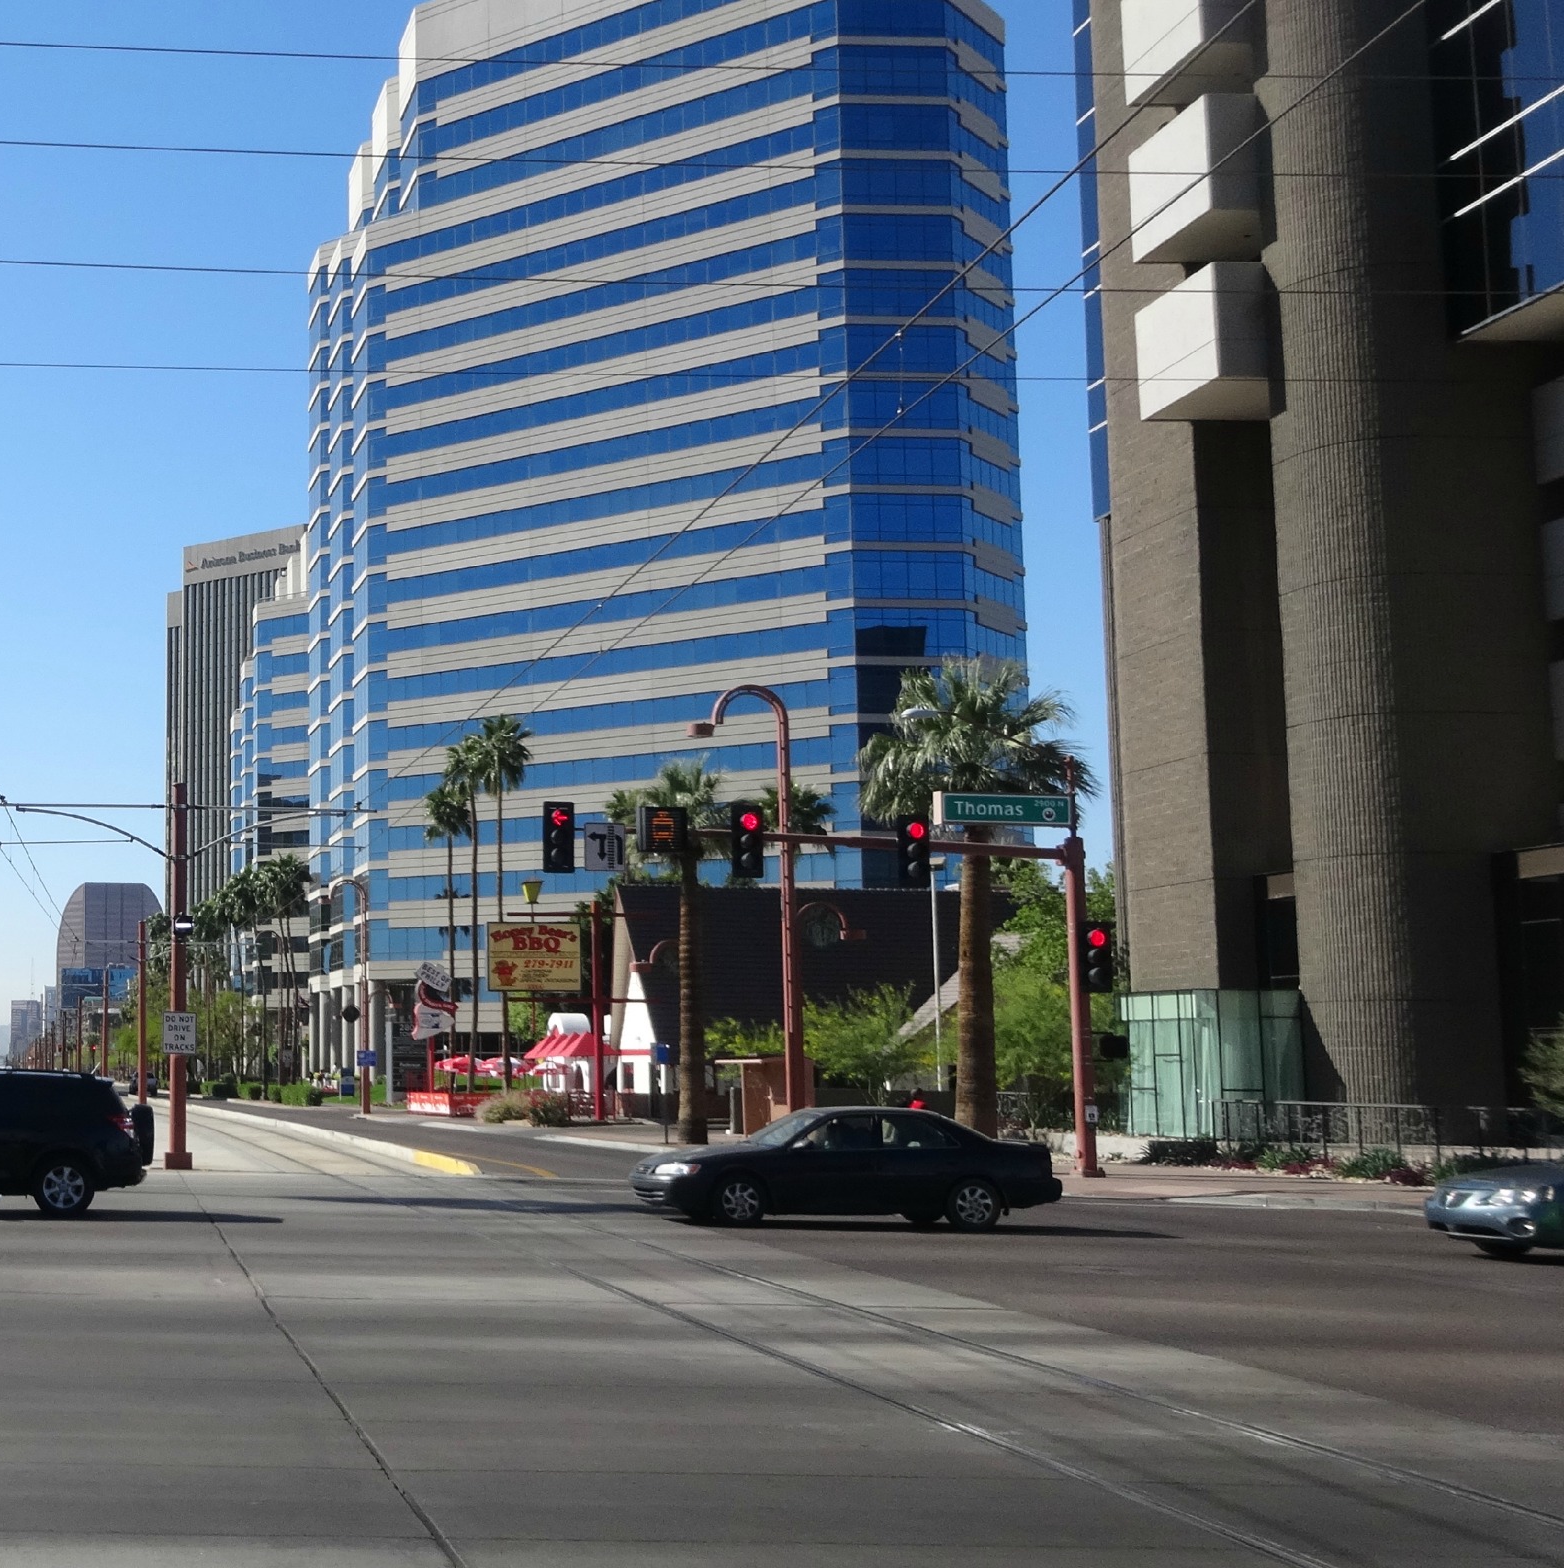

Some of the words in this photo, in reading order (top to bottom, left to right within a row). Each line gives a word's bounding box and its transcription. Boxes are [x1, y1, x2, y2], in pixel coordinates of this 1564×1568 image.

[238, 547, 277, 562] Business
[954, 801, 1024, 816] Thomas
[1034, 799, 1055, 807] 2900
[490, 927, 534, 942] Honey
[512, 936, 562, 955] BBQ
[523, 959, 574, 968] 279-7911
[420, 971, 446, 987] PHILLY
[421, 963, 441, 977] BEST
[440, 975, 451, 984] OF
[164, 1043, 195, 1051] TRACKS
